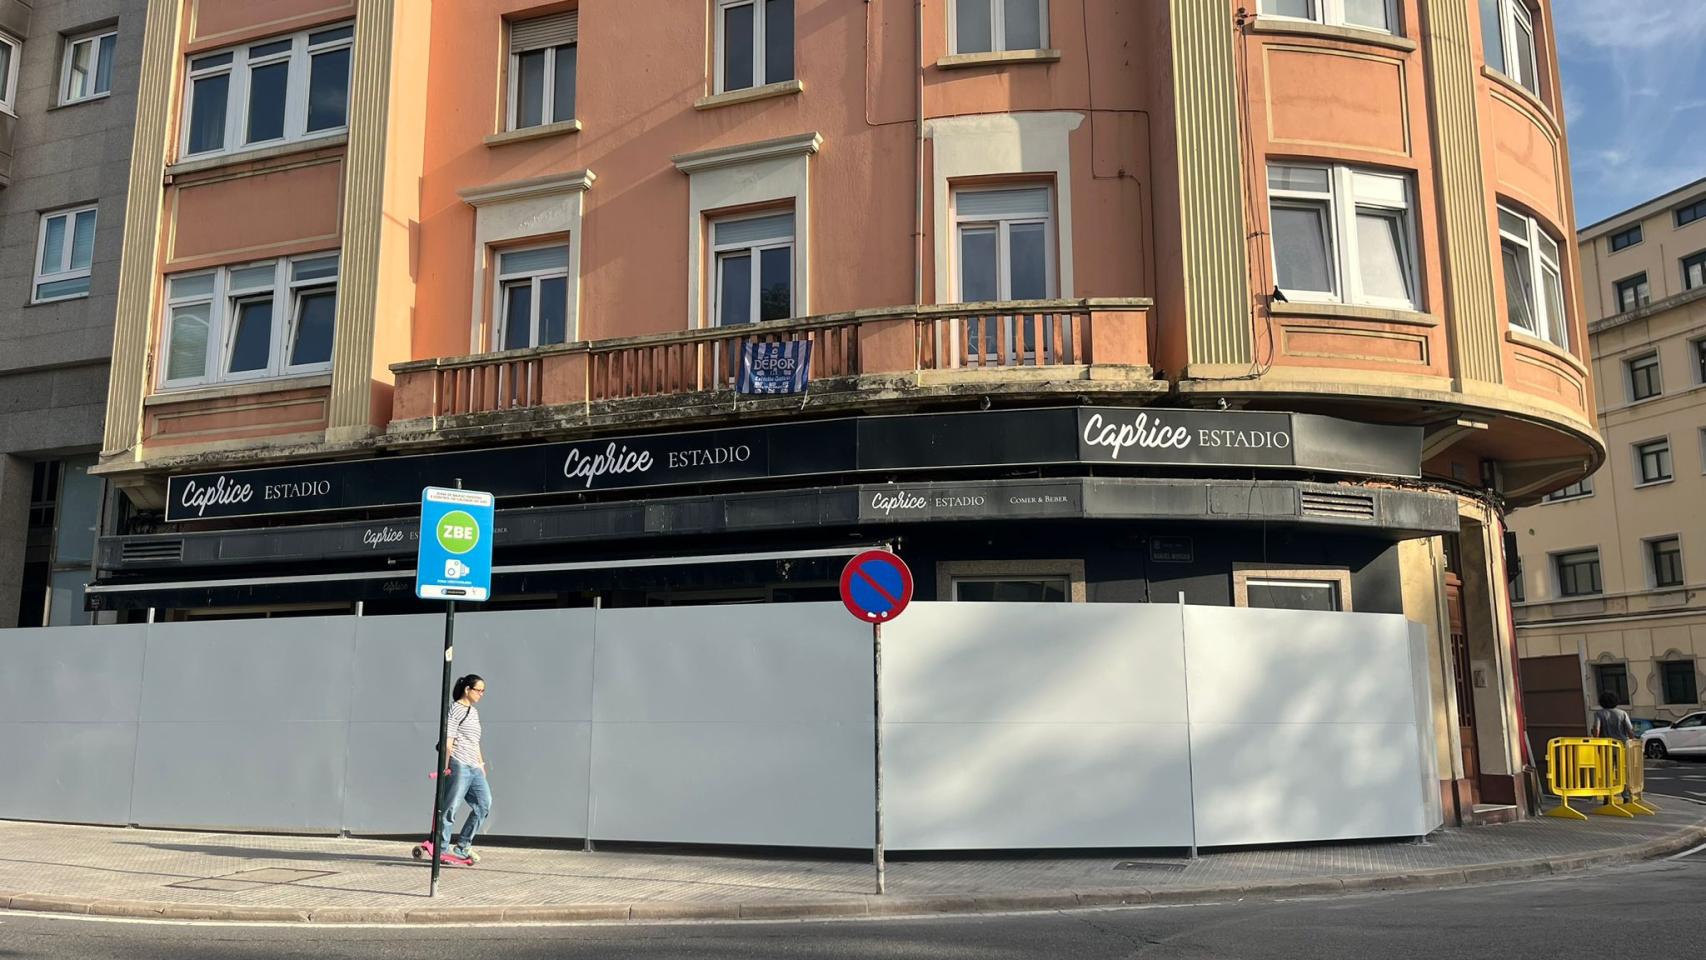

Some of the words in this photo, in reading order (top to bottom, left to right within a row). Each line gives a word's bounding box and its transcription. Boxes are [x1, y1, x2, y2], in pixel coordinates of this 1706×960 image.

[1083, 411, 1191, 460] Caprice
[1198, 429, 1290, 449] ESTADIO
[563, 442, 654, 488] Caprice
[668, 444, 751, 469] ESTADIO
[181, 475, 254, 517] Caprice
[264, 480, 331, 501] ESTADIO
[871, 490, 927, 516] Caprice
[935, 496, 985, 508] ESTADIO
[363, 526, 404, 549] Caprice
[443, 525, 474, 540] ZBE
